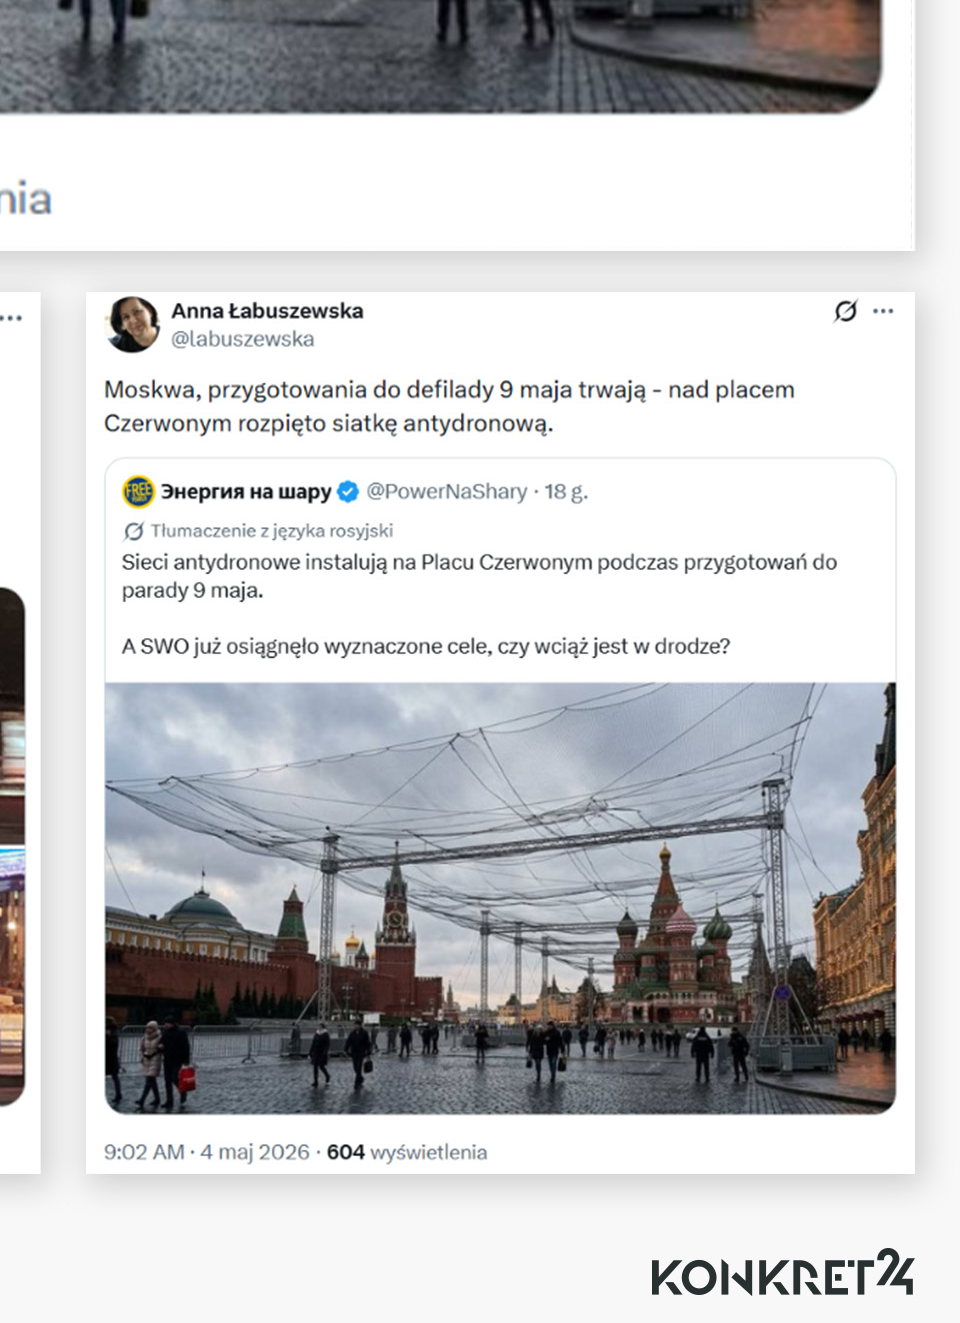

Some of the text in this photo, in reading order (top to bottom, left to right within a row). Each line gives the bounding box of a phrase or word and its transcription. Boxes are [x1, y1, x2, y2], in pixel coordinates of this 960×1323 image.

[170, 301, 365, 320] Anna Łabuszewska
[171, 329, 315, 349] @labuszewska
[104, 378, 202, 403] Moskwa,
[208, 379, 368, 404] przygotowania
[372, 378, 402, 399] do
[406, 378, 495, 404] defilady
[499, 379, 514, 399] 9
[519, 379, 573, 404] maja
[577, 379, 647, 404] trwają
[668, 378, 709, 399] nad
[715, 378, 795, 404] placem
[103, 412, 554, 438] Czerwonym rozpięto siatkę antydronową.
[126, 482, 153, 497] FREE
[160, 483, 333, 505] Энергия на шару
[366, 481, 589, 505] @PowerNaShary 18 g.
[150, 522, 394, 542] Tłumaczenie z języka rosyjski
[121, 552, 838, 575] Sieci antydronowe instalują na Placu Czerwonym podczas przygotowań do
[122, 580, 264, 603] parady 9 maja.
[121, 636, 731, 660] A SWO już osiągnęło wyznaczone cele, czy wciąż jest w drodze?
[103, 1142, 488, 1165] 9:02 AM 4 maj 2026 604 wyświetlenia
